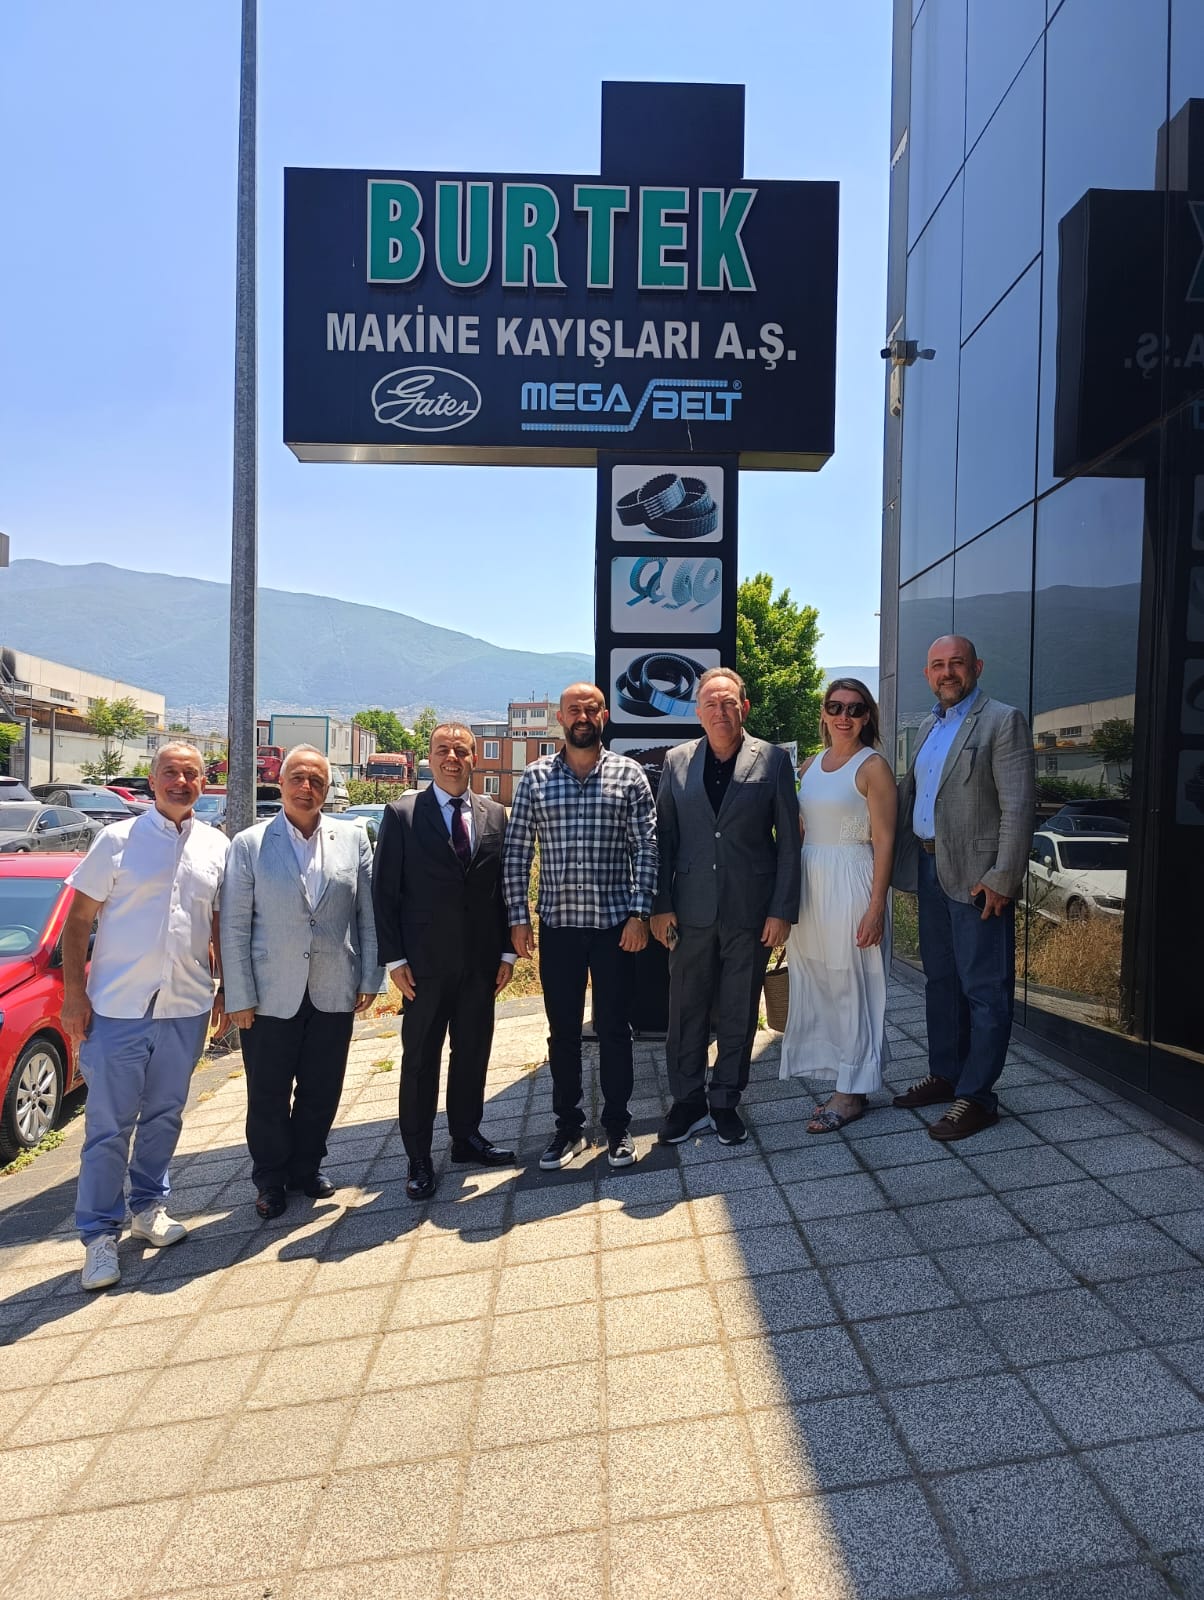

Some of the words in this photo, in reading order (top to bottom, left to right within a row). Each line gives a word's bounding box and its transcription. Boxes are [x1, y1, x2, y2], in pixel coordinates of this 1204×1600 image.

[366, 178, 759, 292] BURTEK
[326, 305, 480, 354] MAKİNE
[497, 316, 699, 368] KAYIŞLARI
[714, 322, 798, 371] A.Ş.
[374, 374, 476, 424] Gates
[520, 381, 632, 413] MEGA
[652, 390, 743, 421] BELT
